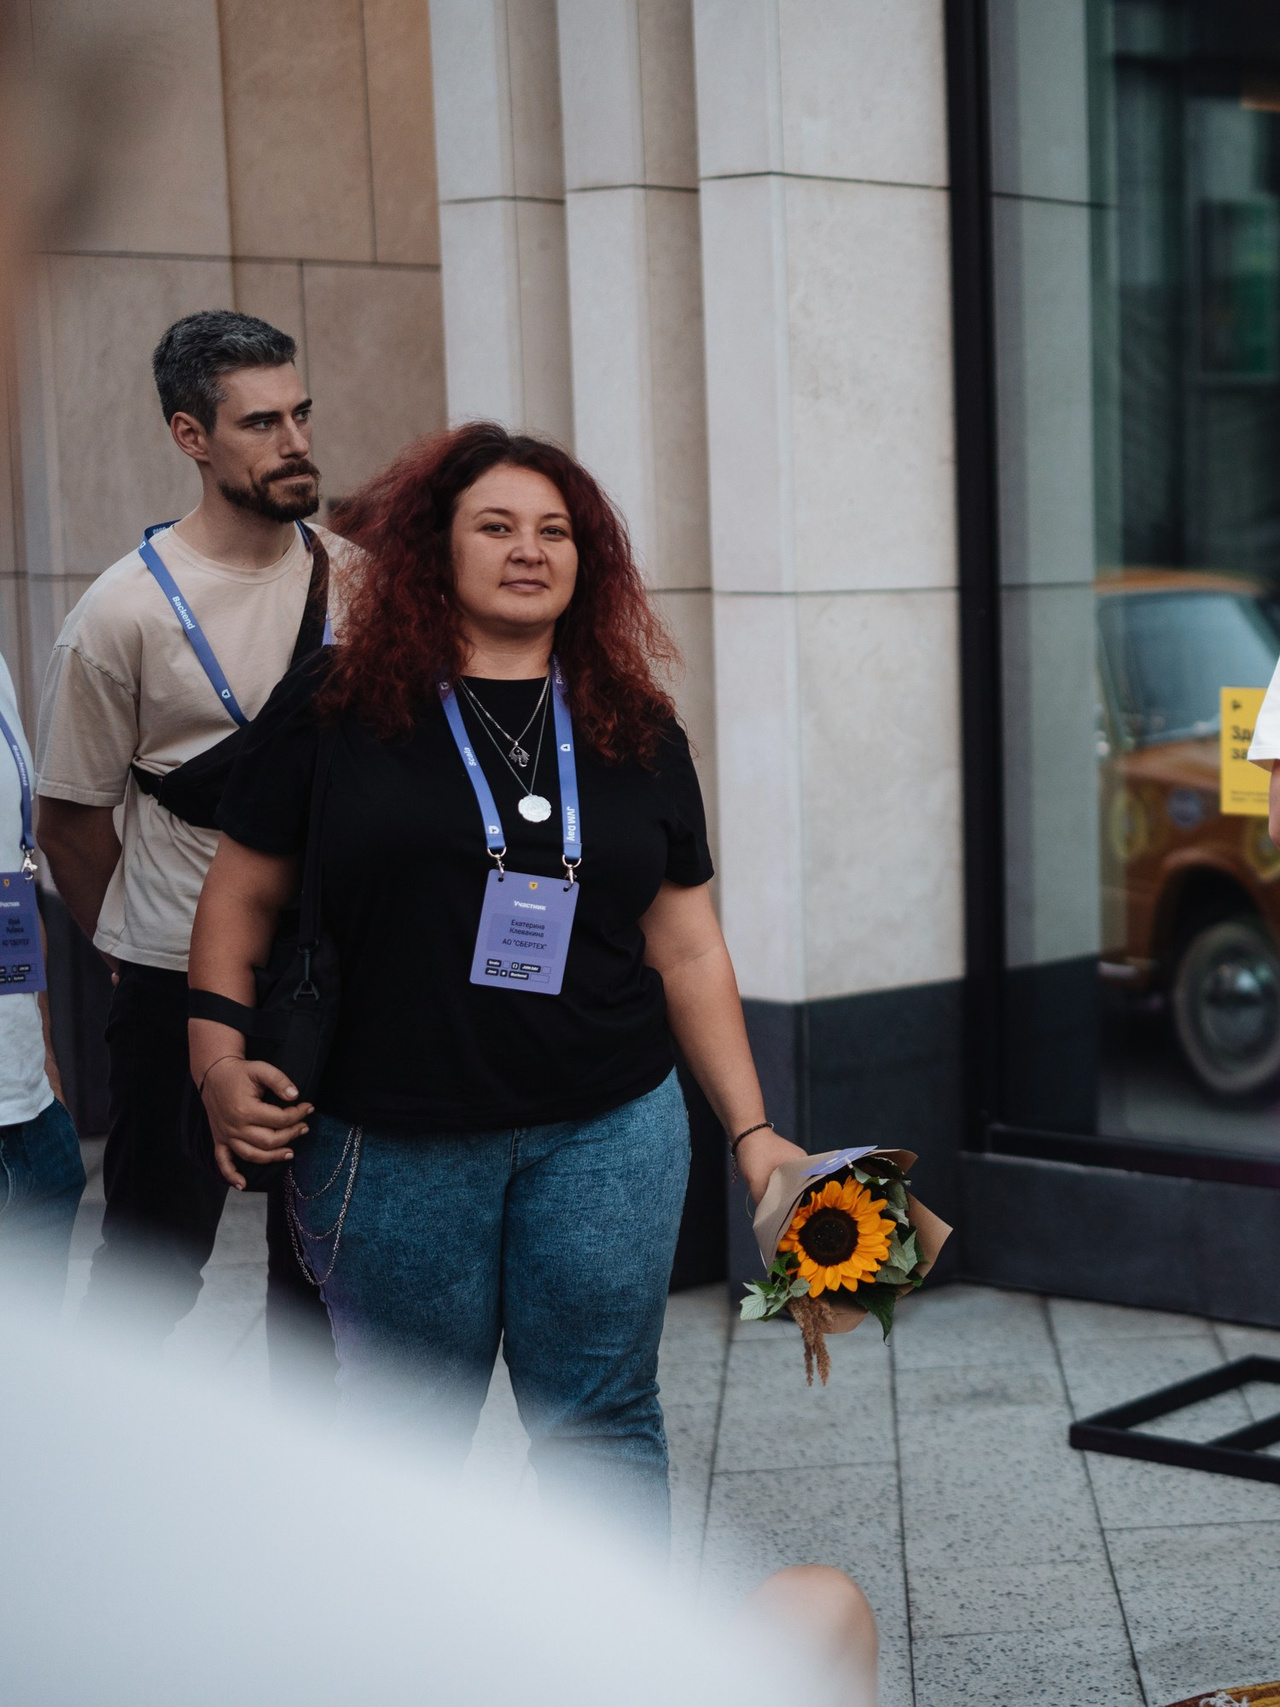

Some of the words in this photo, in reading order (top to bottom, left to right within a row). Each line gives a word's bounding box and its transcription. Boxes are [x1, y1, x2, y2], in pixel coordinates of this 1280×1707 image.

[172, 596, 195, 630] Backend
[566, 806, 577, 824] JVM
[566, 824, 577, 842] Day
[513, 900, 546, 911] Участник
[511, 919, 546, 930] Екатерина
